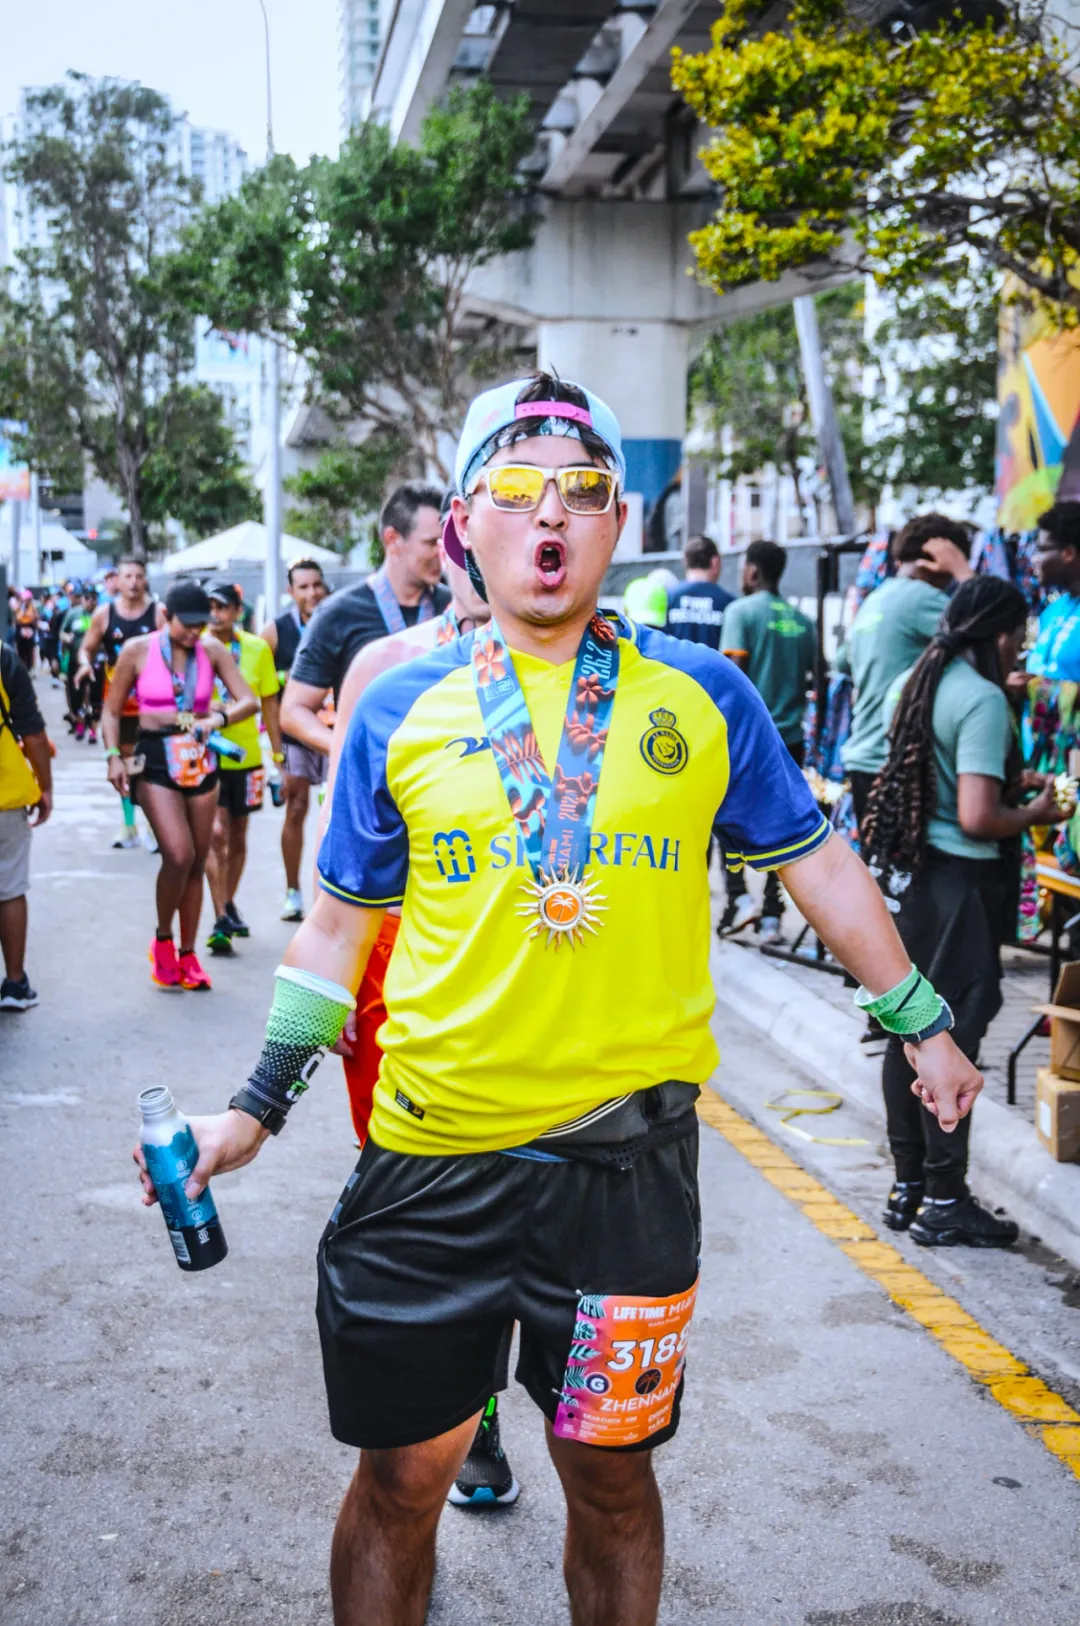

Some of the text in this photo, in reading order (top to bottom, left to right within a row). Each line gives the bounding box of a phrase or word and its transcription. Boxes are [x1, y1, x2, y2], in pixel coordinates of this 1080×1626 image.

[679, 596, 713, 610] FIRE
[581, 640, 613, 680] 26.2
[613, 1306, 638, 1320] LIFE
[638, 1305, 668, 1319] TIME
[589, 1377, 605, 1391] G
[600, 1381, 677, 1413] ZHENNAN
